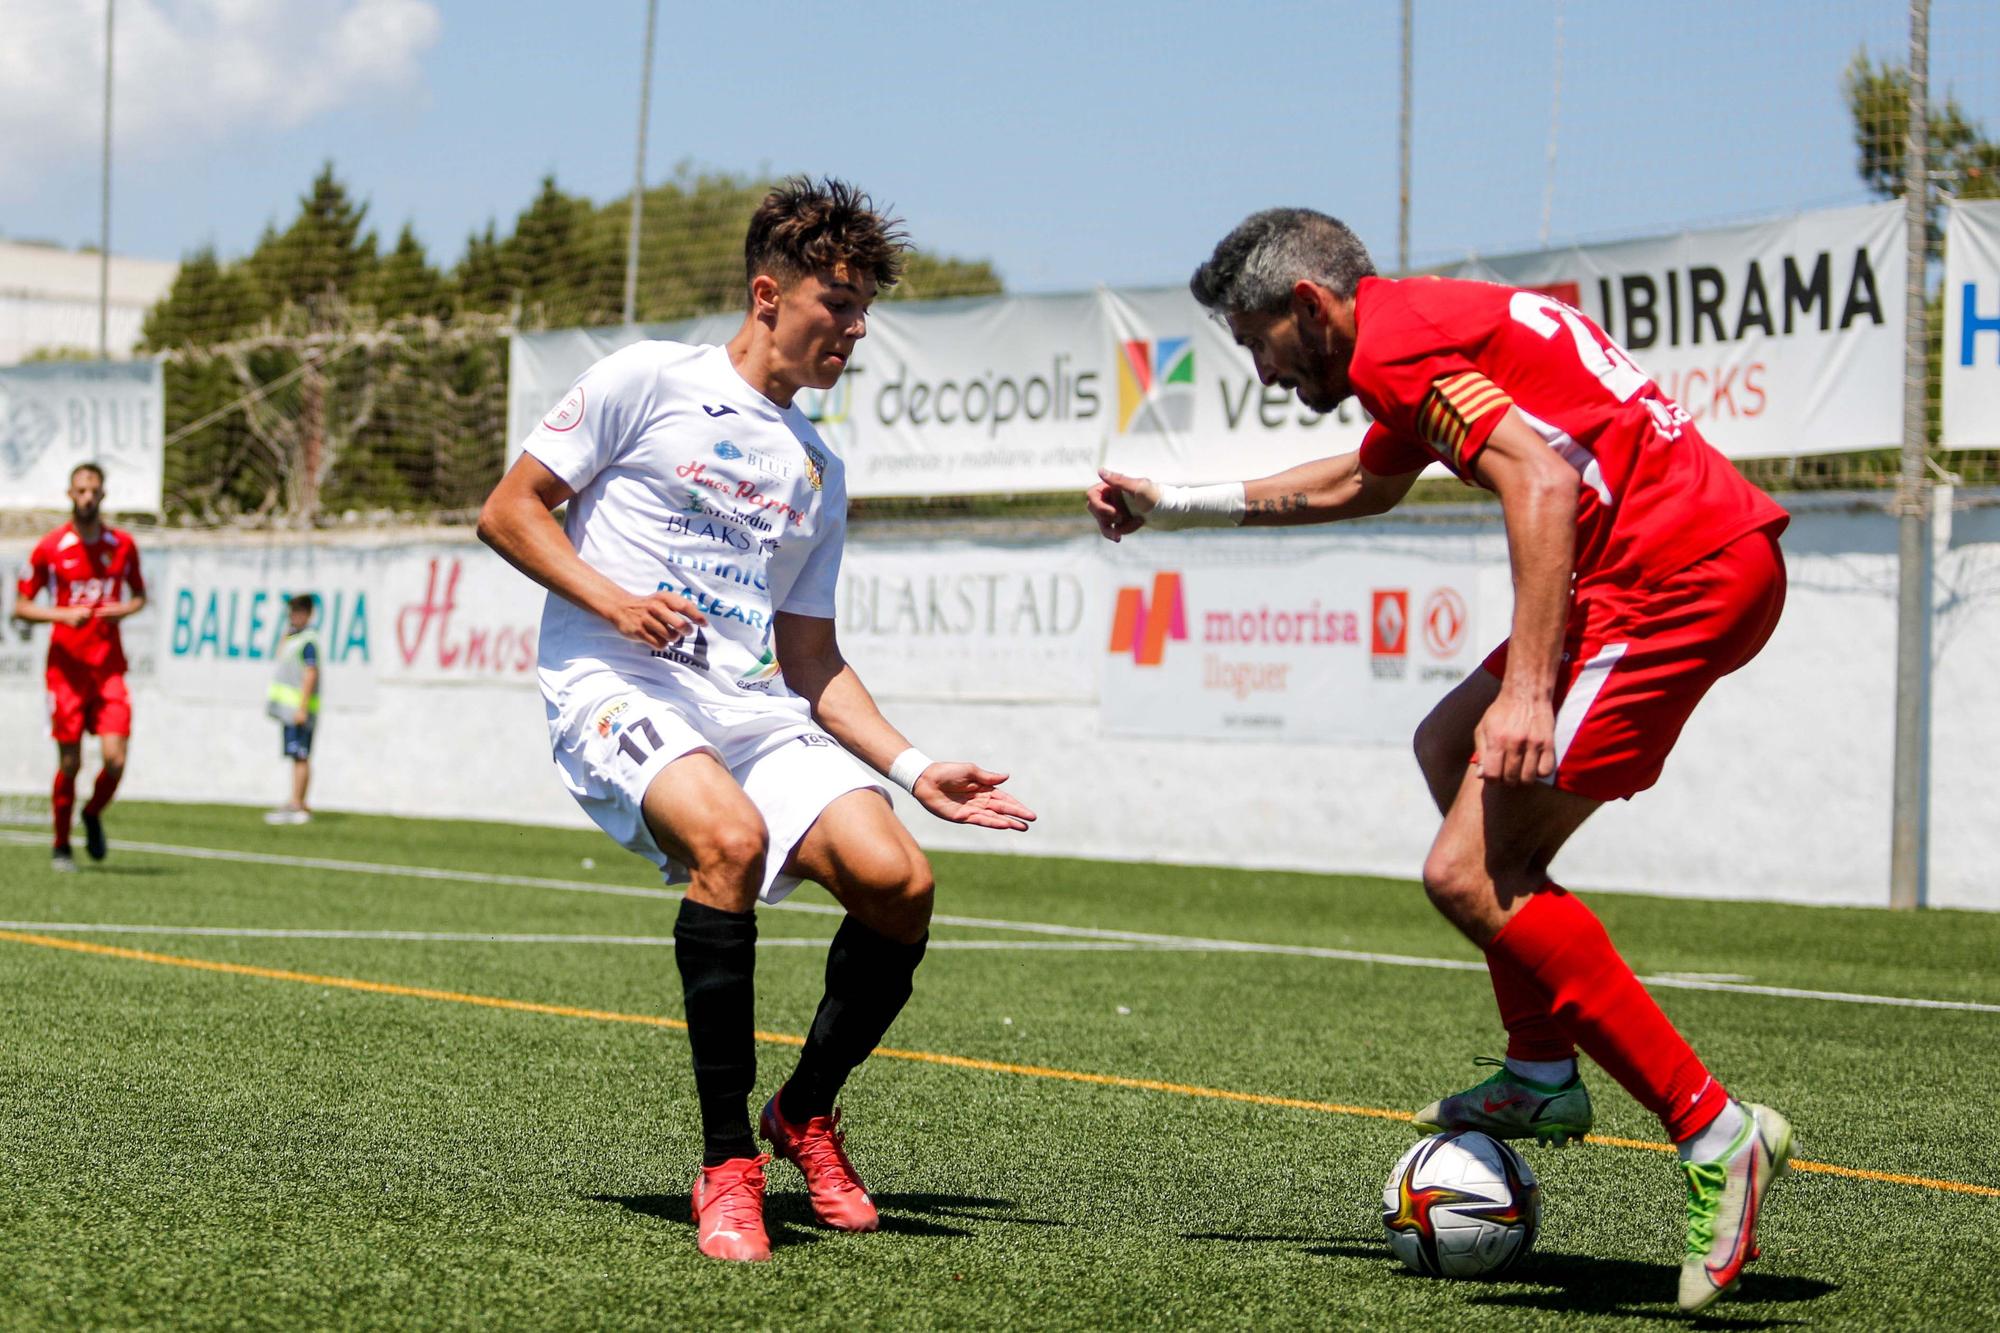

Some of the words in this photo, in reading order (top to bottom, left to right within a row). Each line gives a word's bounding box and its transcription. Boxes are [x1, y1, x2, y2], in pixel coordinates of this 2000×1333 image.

[1599, 248, 1884, 350] IBIRAMA
[68, 399, 153, 451] BLUE
[747, 453, 792, 481] BLUE
[735, 480, 805, 527] Parrot
[845, 572, 1084, 637] BLAKSTAD
[1204, 600, 1360, 646] motorisa
[1204, 655, 1289, 700] lloguer
[616, 716, 665, 767] 17
